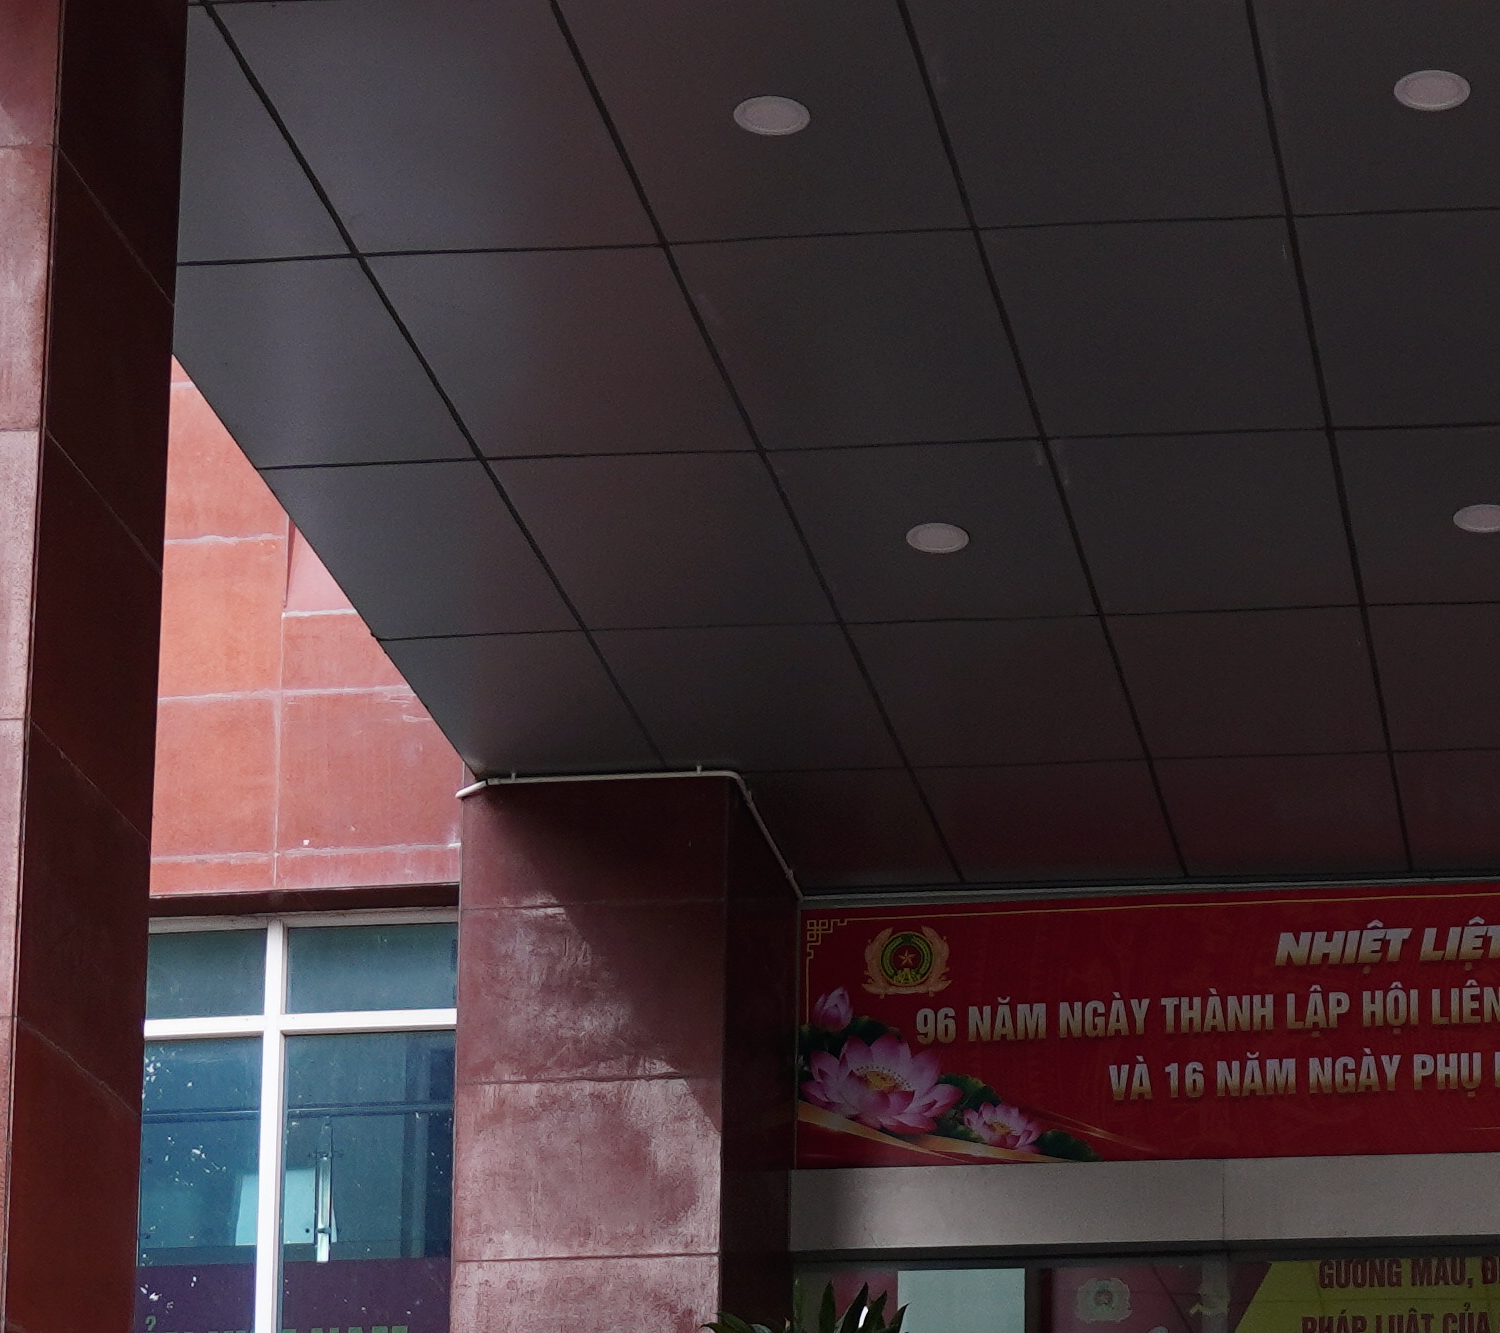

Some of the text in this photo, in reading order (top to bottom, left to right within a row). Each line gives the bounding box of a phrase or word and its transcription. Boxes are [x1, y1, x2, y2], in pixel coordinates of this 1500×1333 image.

[1275, 919, 1413, 974] NHIỆT
[915, 1007, 957, 1045] 96
[966, 996, 1047, 1042] NĂM
[1058, 992, 1152, 1039] NGÀY
[1160, 987, 1274, 1034] THÀNH
[1285, 984, 1351, 1037] LẬP
[1361, 982, 1420, 1034] HỘI
[1108, 1055, 1153, 1101] VÀ
[1165, 1061, 1205, 1098] 16
[1216, 1051, 1297, 1096] NĂM
[1308, 1048, 1401, 1094] NGÀY
[1412, 1052, 1482, 1097] PHỤ
